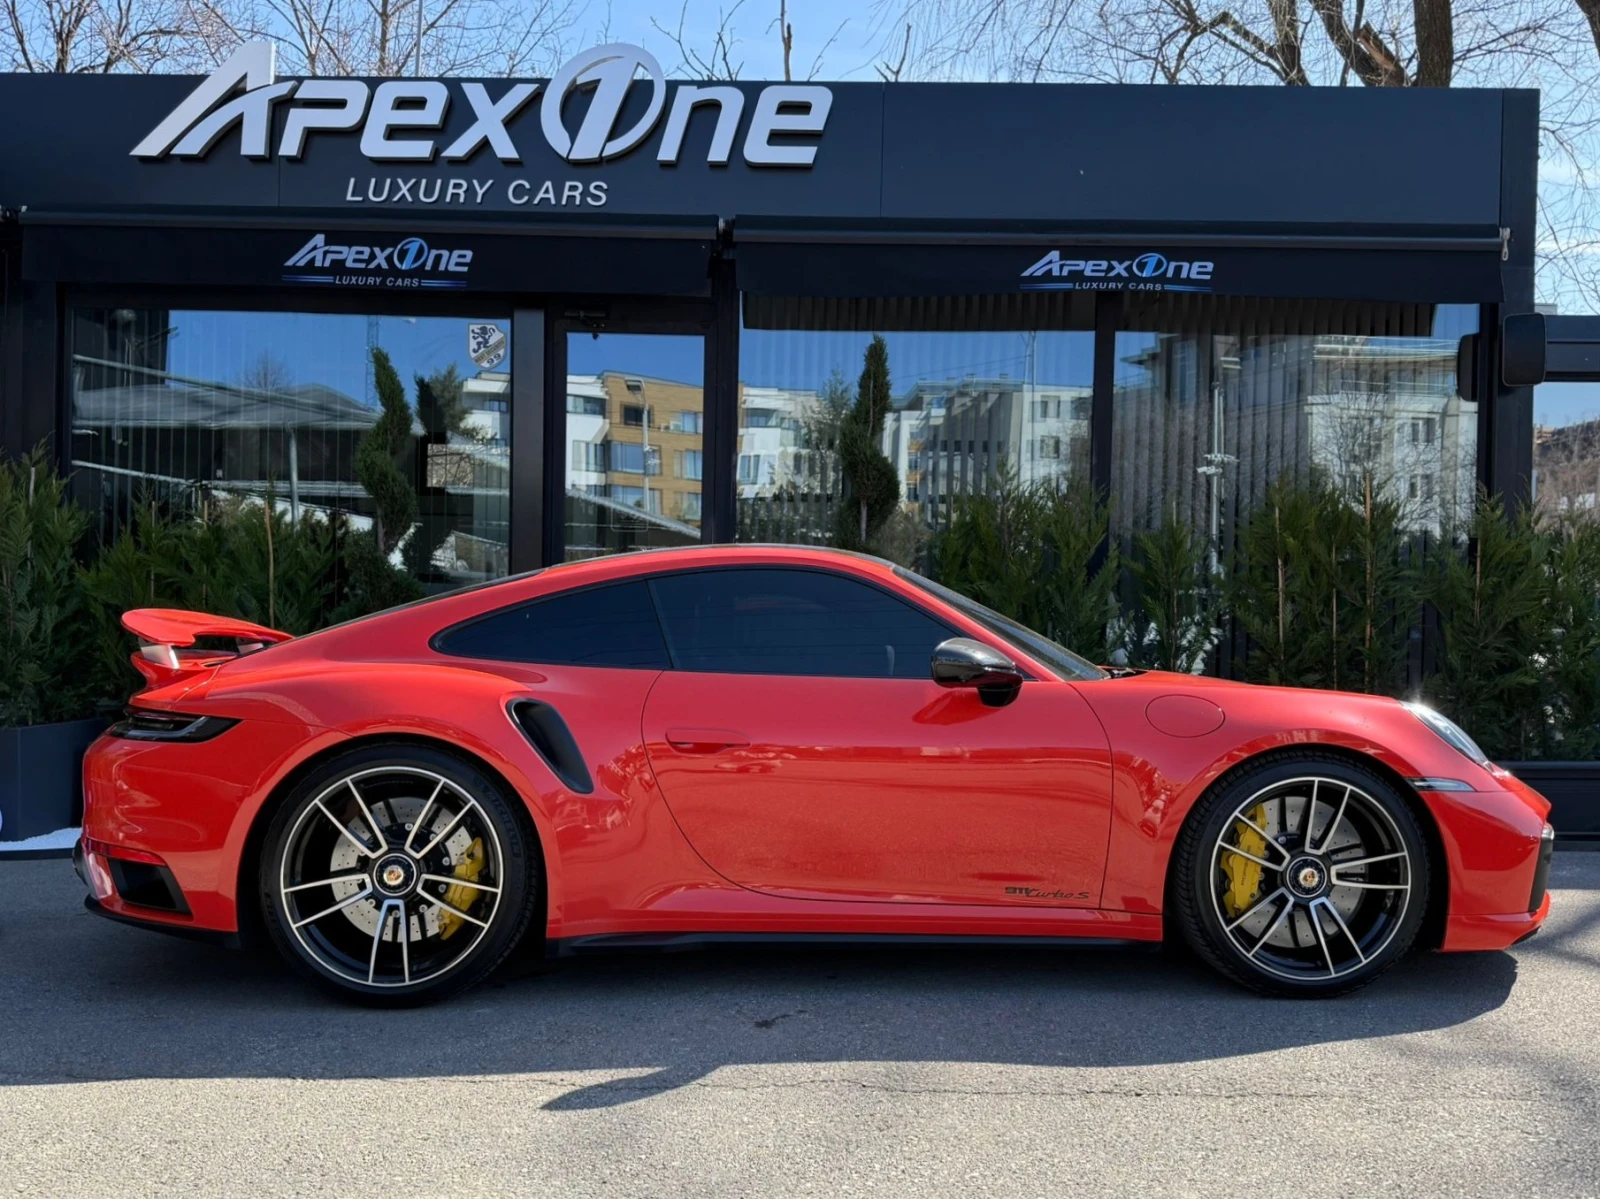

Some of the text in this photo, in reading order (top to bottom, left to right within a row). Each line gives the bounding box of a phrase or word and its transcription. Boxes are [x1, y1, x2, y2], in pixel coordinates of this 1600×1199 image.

[345, 176, 609, 207] LUXURY CARS
[335, 276, 419, 288] LUXURY CARS
[1075, 282, 1162, 291] LUXURY CARS
[487, 352, 501, 366] 99
[1026, 888, 1074, 899] Turbo
[1074, 891, 1090, 899] S
